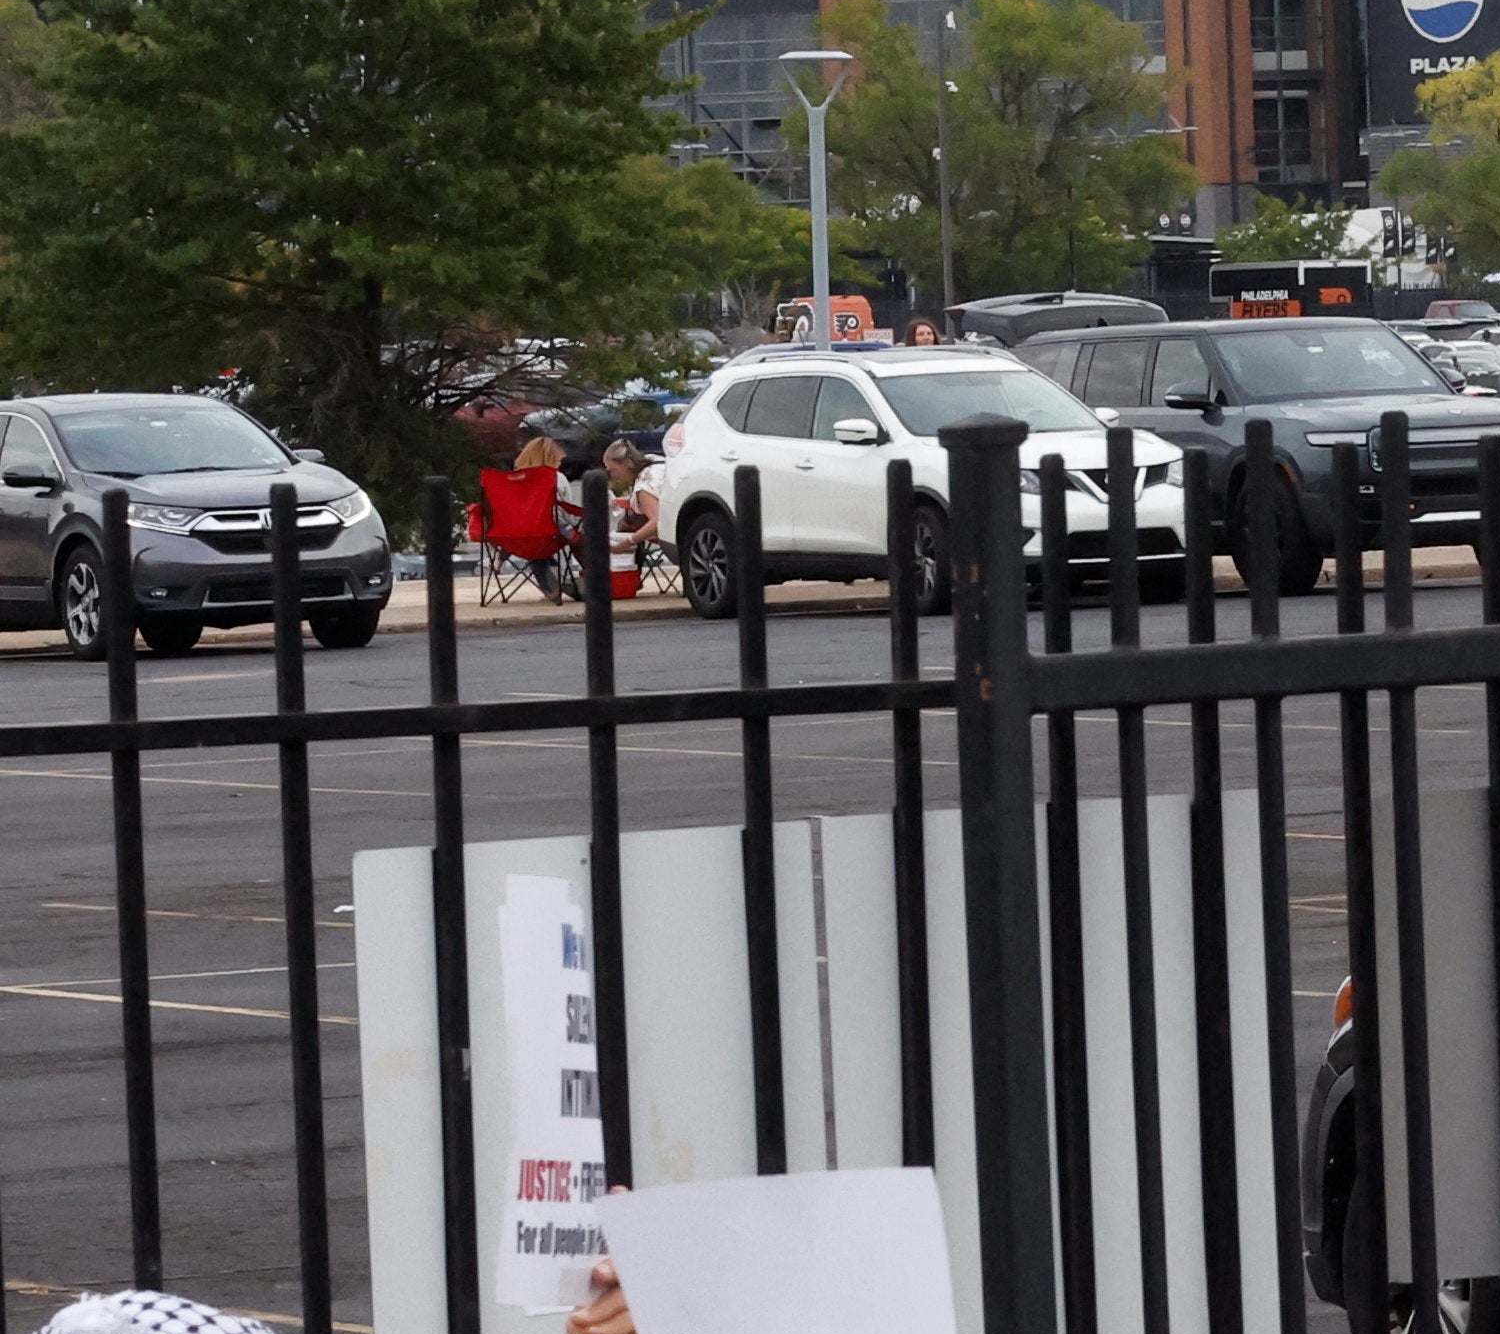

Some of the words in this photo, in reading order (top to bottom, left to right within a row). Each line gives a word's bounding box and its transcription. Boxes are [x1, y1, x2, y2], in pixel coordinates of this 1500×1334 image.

[1410, 56, 1477, 75] PLAZA
[1241, 289, 1289, 302] PHILADELPHIA
[516, 1159, 571, 1203] JUSTICE
[516, 1220, 537, 1255] For
[538, 1220, 553, 1255] all
